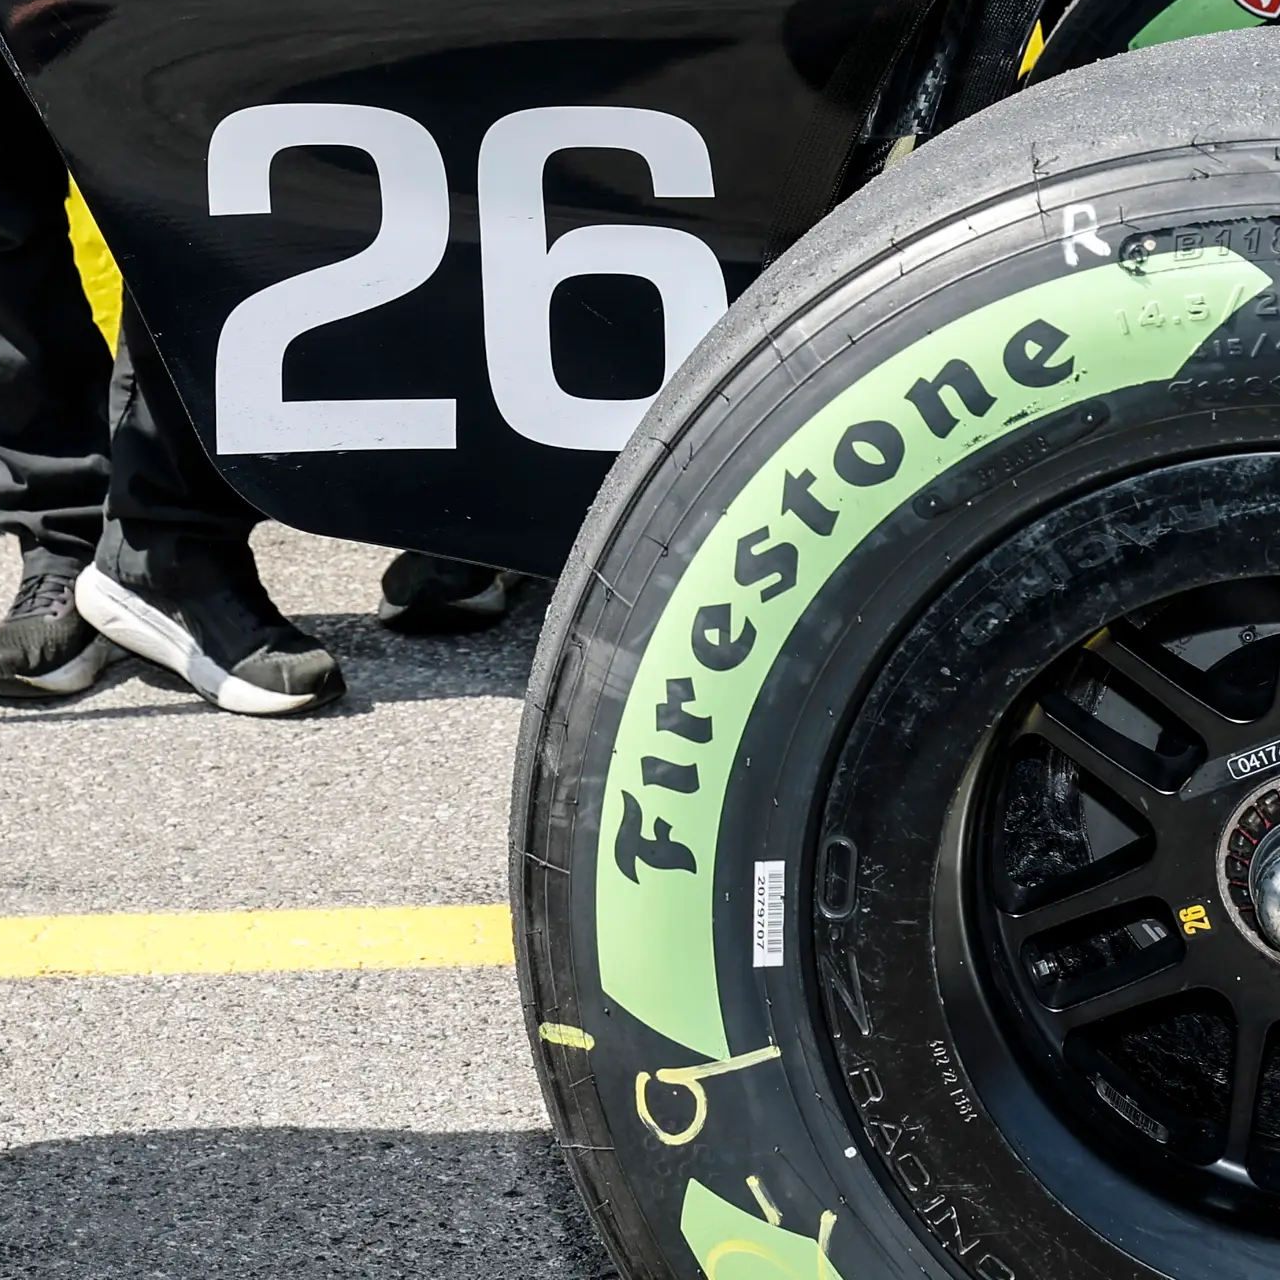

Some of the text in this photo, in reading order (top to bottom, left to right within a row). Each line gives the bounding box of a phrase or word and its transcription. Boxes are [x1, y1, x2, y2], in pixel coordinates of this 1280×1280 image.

[1063, 204, 1112, 267] R
[207, 103, 729, 454] 26
[614, 318, 1076, 886] Firestone
[756, 876, 766, 951] 2079707
[1179, 903, 1213, 937] 26
